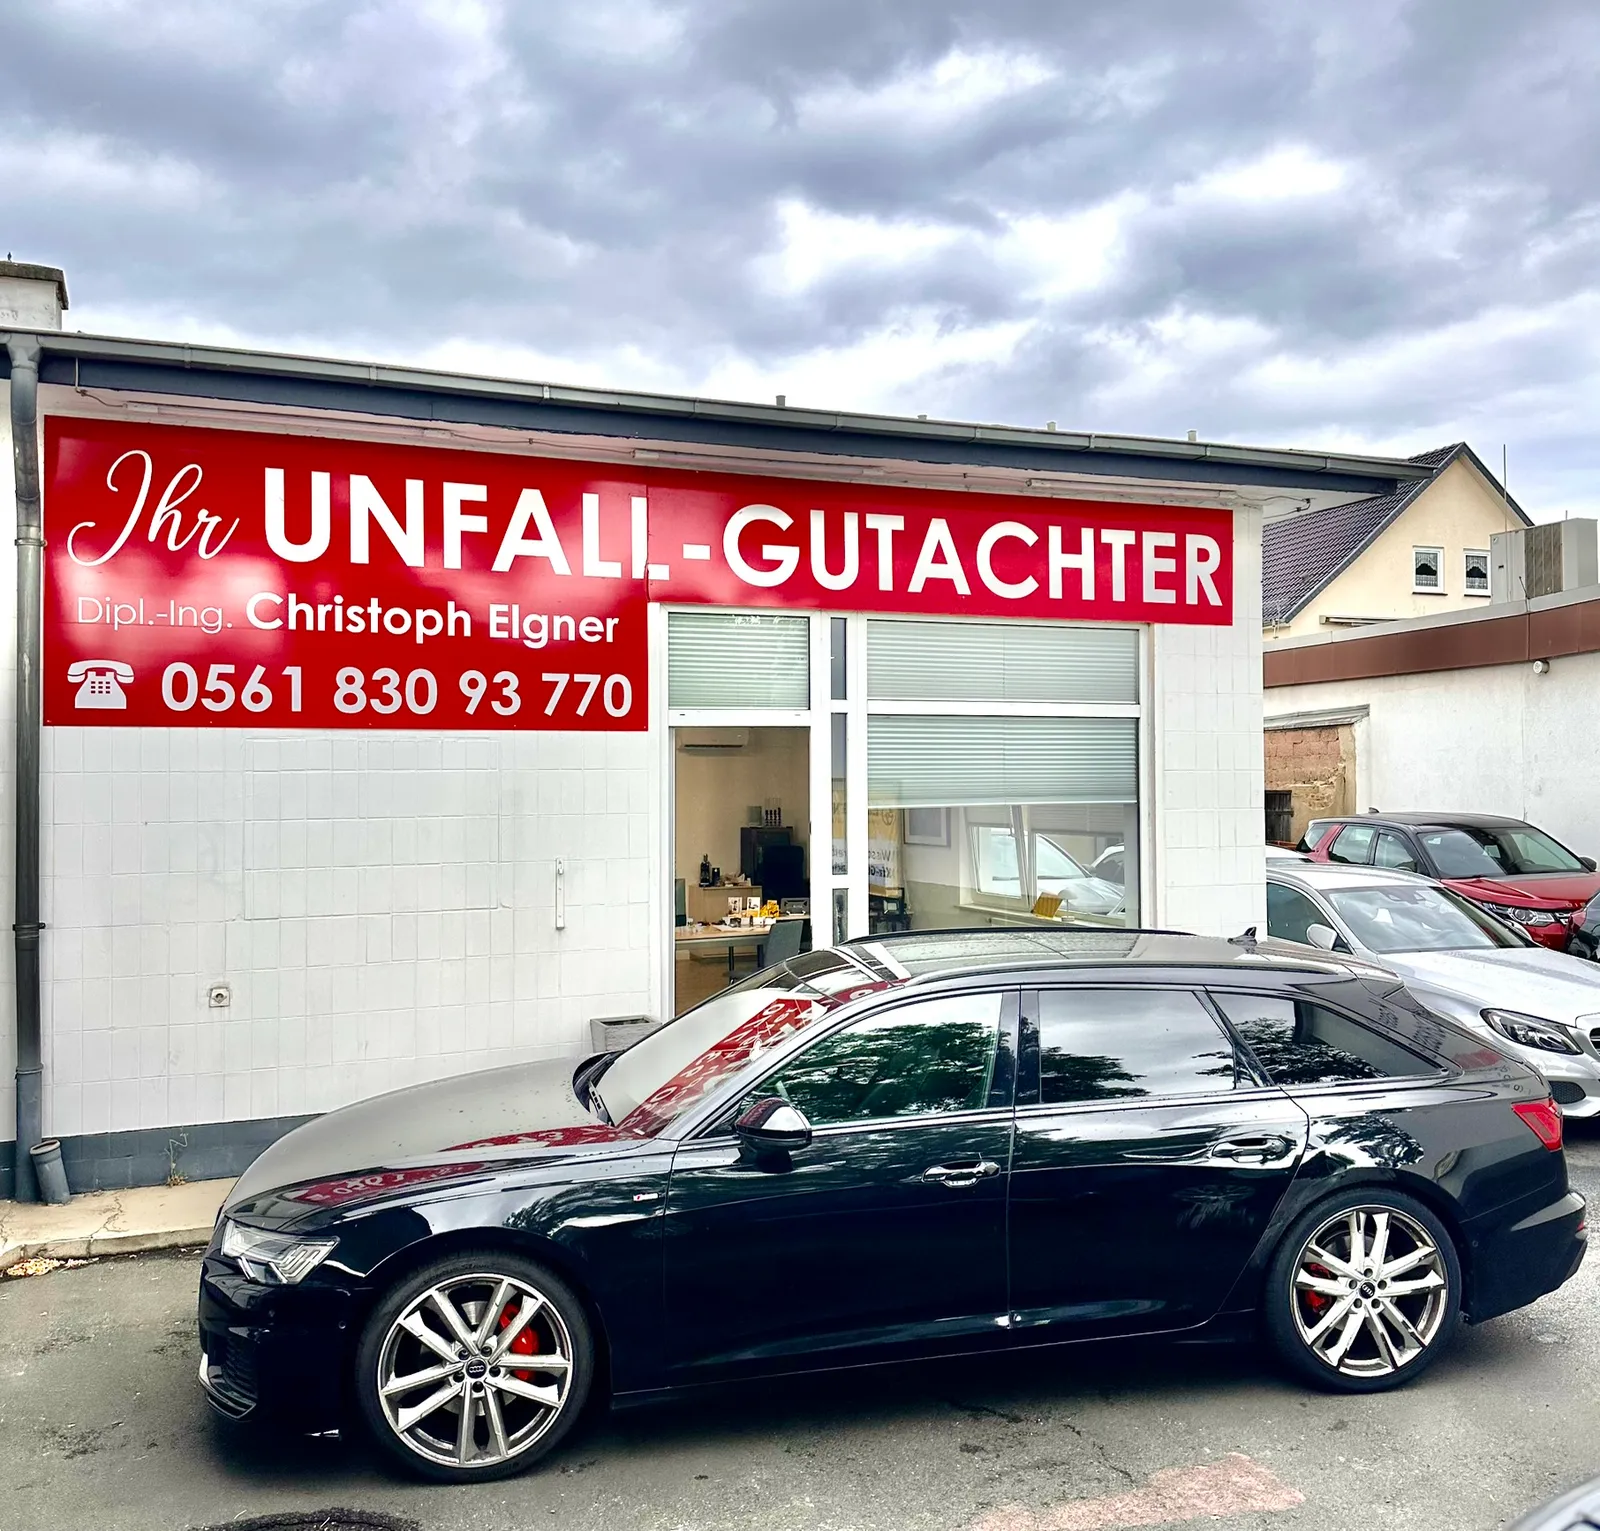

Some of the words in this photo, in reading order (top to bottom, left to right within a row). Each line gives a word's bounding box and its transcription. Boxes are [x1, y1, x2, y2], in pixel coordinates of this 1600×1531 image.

[66, 449, 240, 567] Ihr
[77, 596, 233, 634] Dipl.-Ing.
[246, 591, 471, 643] Christoph
[489, 603, 619, 648] Elgner
[161, 662, 302, 713] 0561
[333, 667, 437, 715] 830
[459, 671, 520, 716] 93
[541, 673, 632, 718] 770
